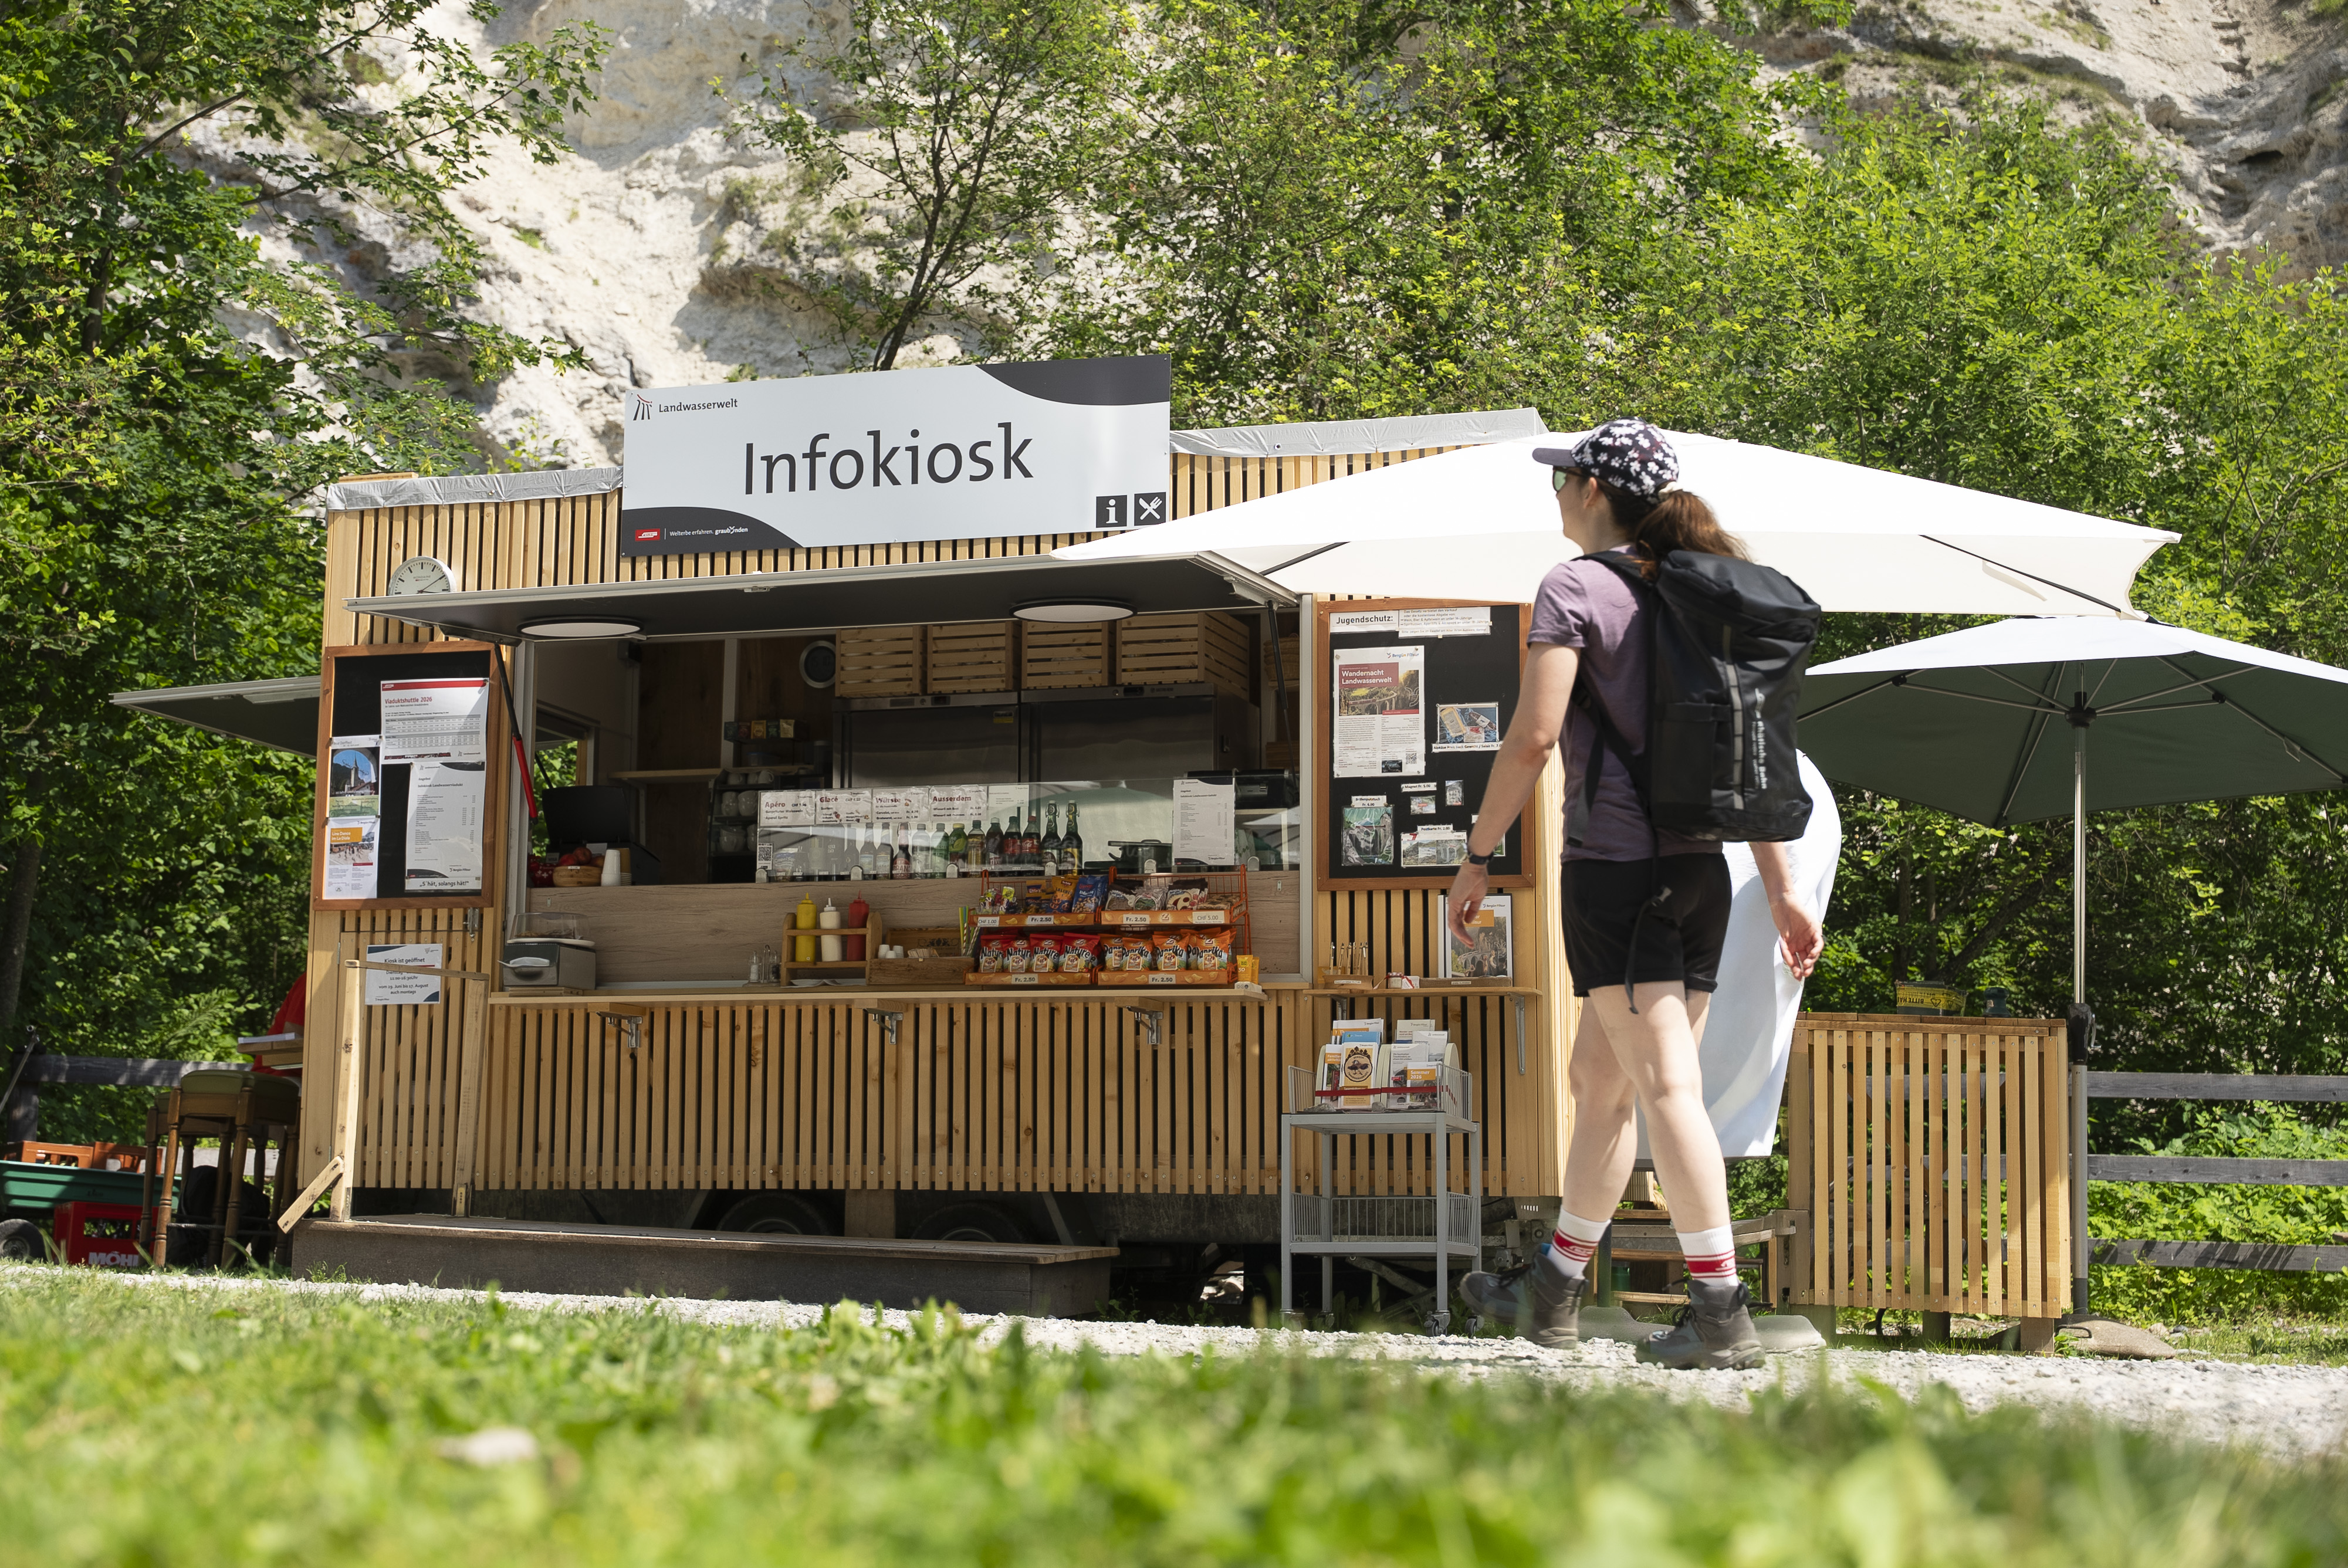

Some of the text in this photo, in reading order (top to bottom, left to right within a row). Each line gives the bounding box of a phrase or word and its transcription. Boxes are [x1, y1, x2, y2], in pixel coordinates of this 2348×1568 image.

[659, 398, 737, 412] Landwasserwelt
[745, 422, 1034, 495] Infokiosk
[1336, 615, 1393, 625] Jugendschutz:
[765, 801, 786, 809] Apéro
[1162, 913, 1169, 921] Z
[980, 946, 1003, 961] Natur
[1006, 947, 1031, 961] Natur
[1033, 946, 1060, 959] Nature
[1064, 945, 1091, 959] Nature
[1122, 946, 1149, 959] Paprika
[1157, 945, 1184, 958] Paprika
[1197, 945, 1223, 959] Paprika
